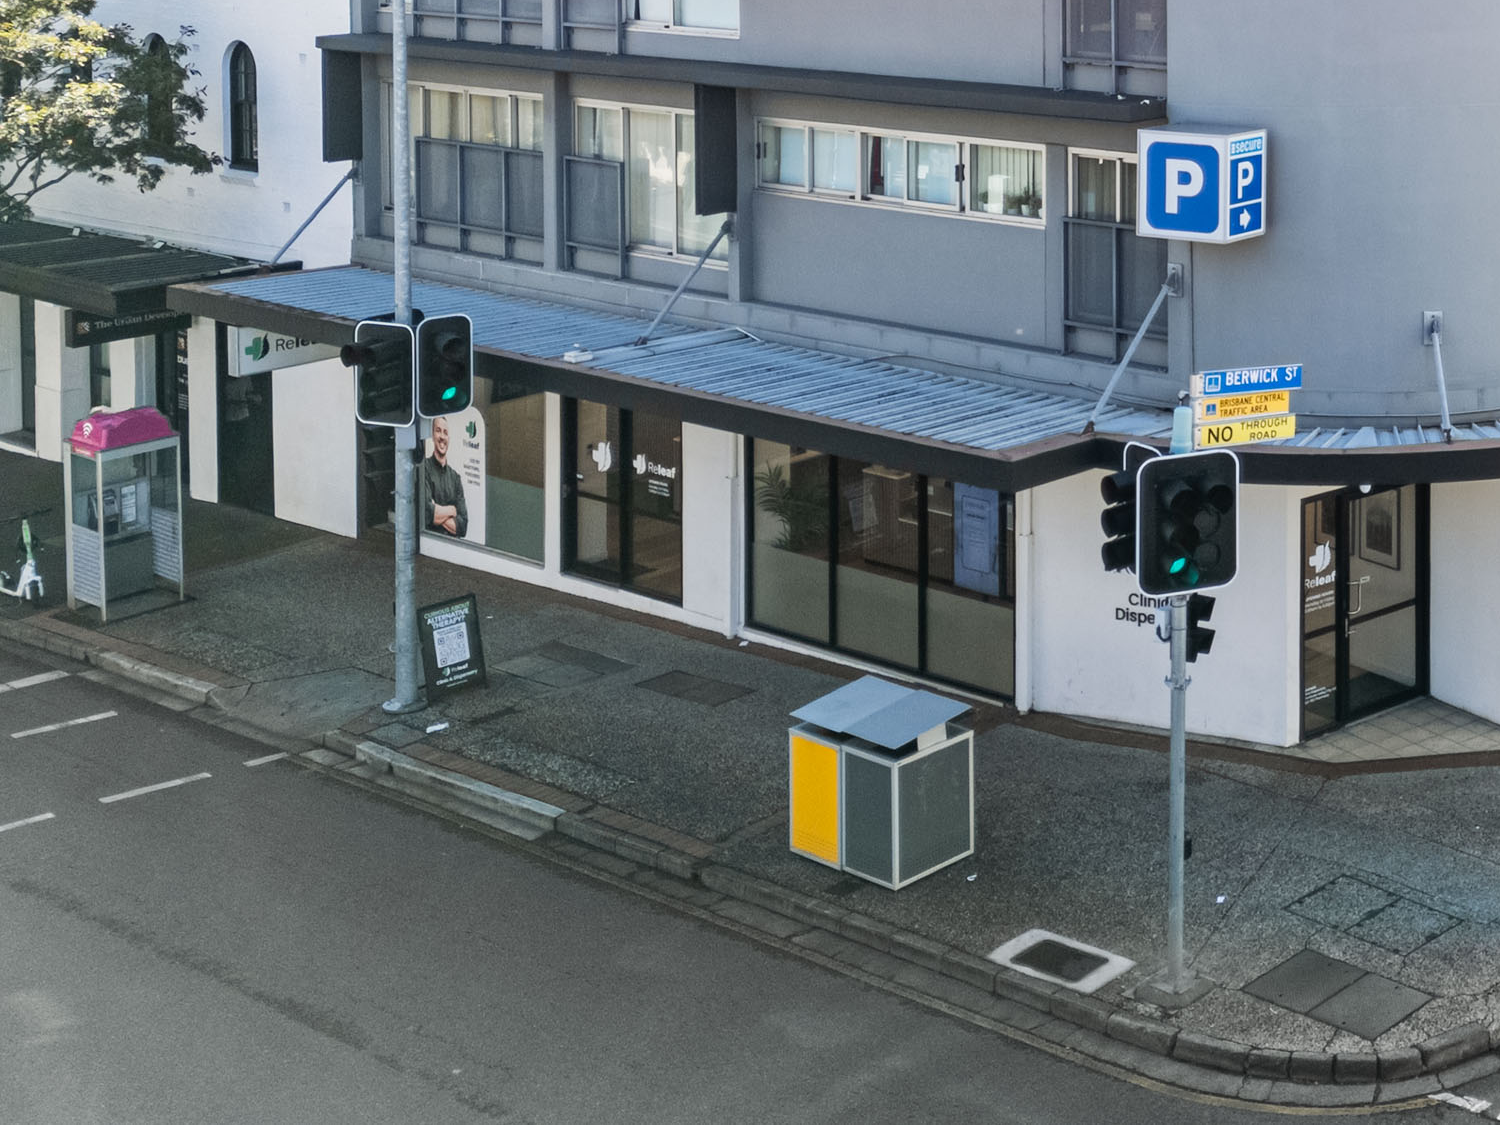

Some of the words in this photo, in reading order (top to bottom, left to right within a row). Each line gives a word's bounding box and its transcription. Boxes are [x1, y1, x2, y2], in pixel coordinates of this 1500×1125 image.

[1235, 138, 1262, 154] secure
[1165, 158, 1204, 215] P
[1237, 161, 1254, 200] P
[94, 321, 113, 329] The
[275, 337, 319, 352] Rele
[1225, 368, 1279, 386] BERWICK
[1285, 366, 1298, 381] ST
[1219, 396, 1253, 408] BRISBANE
[1255, 392, 1286, 404] CENTRAL
[1219, 407, 1248, 418] TRAFFIC
[1250, 404, 1268, 414] AREA
[1207, 426, 1233, 444] NO
[1240, 418, 1288, 431] THROUGH
[1249, 430, 1277, 441] ROAD
[647, 462, 676, 479] Releaf
[1304, 570, 1336, 589] Releaf
[1115, 607, 1155, 627] Dispe
